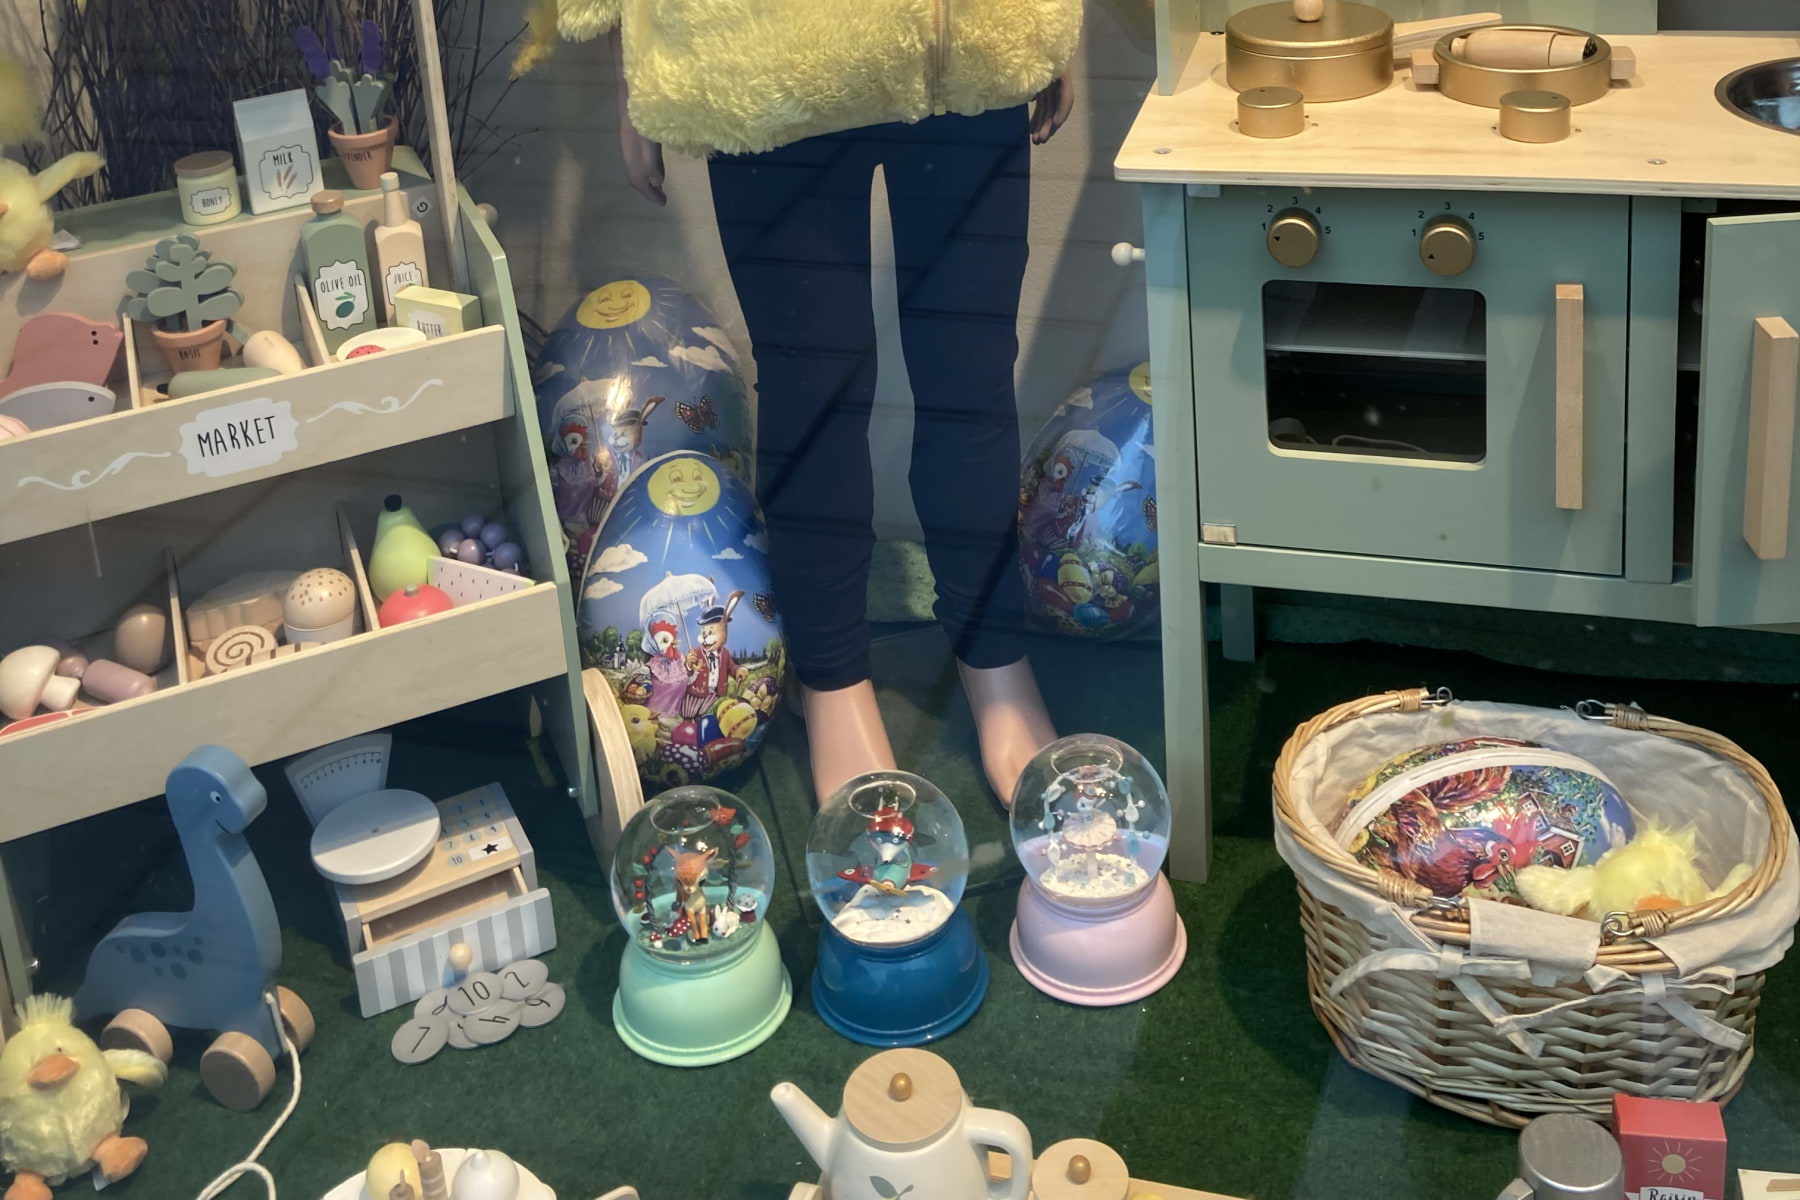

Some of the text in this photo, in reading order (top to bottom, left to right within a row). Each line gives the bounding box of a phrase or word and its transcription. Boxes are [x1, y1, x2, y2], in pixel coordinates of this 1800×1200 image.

[272, 152, 294, 166] MILK
[1262, 196, 1331, 234] 1 2 3 4 5
[1412, 202, 1484, 240] 1 2 3 4 5
[320, 273, 363, 293] OLIVE OIL
[393, 271, 413, 285] JUICE
[197, 415, 275, 458] MARKET
[451, 856, 463, 865] 10
[504, 971, 530, 989] 2
[457, 981, 490, 1006] 10
[411, 1026, 431, 1054] 7
